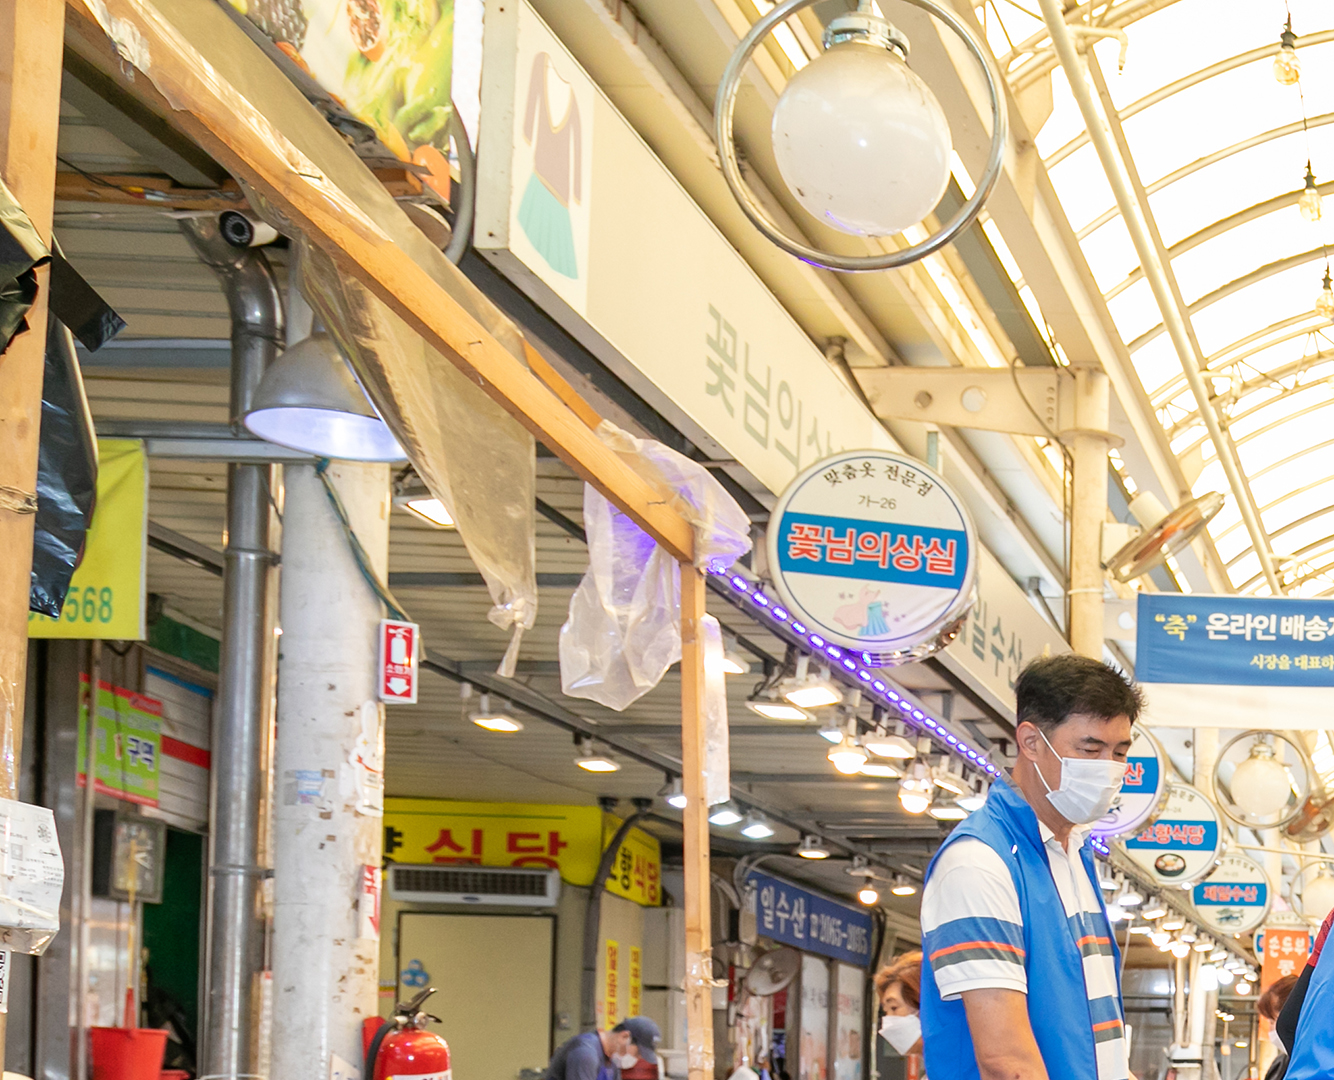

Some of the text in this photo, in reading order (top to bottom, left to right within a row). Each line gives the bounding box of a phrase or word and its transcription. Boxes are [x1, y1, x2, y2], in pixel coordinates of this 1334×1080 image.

[824, 461, 934, 497] 맞춤옷 전문점
[787, 522, 957, 575] 꽃님의상실
[1205, 612, 1277, 641] 온라인
[1250, 654, 1291, 670] 시장을
[1203, 885, 1258, 902] 제일수산
